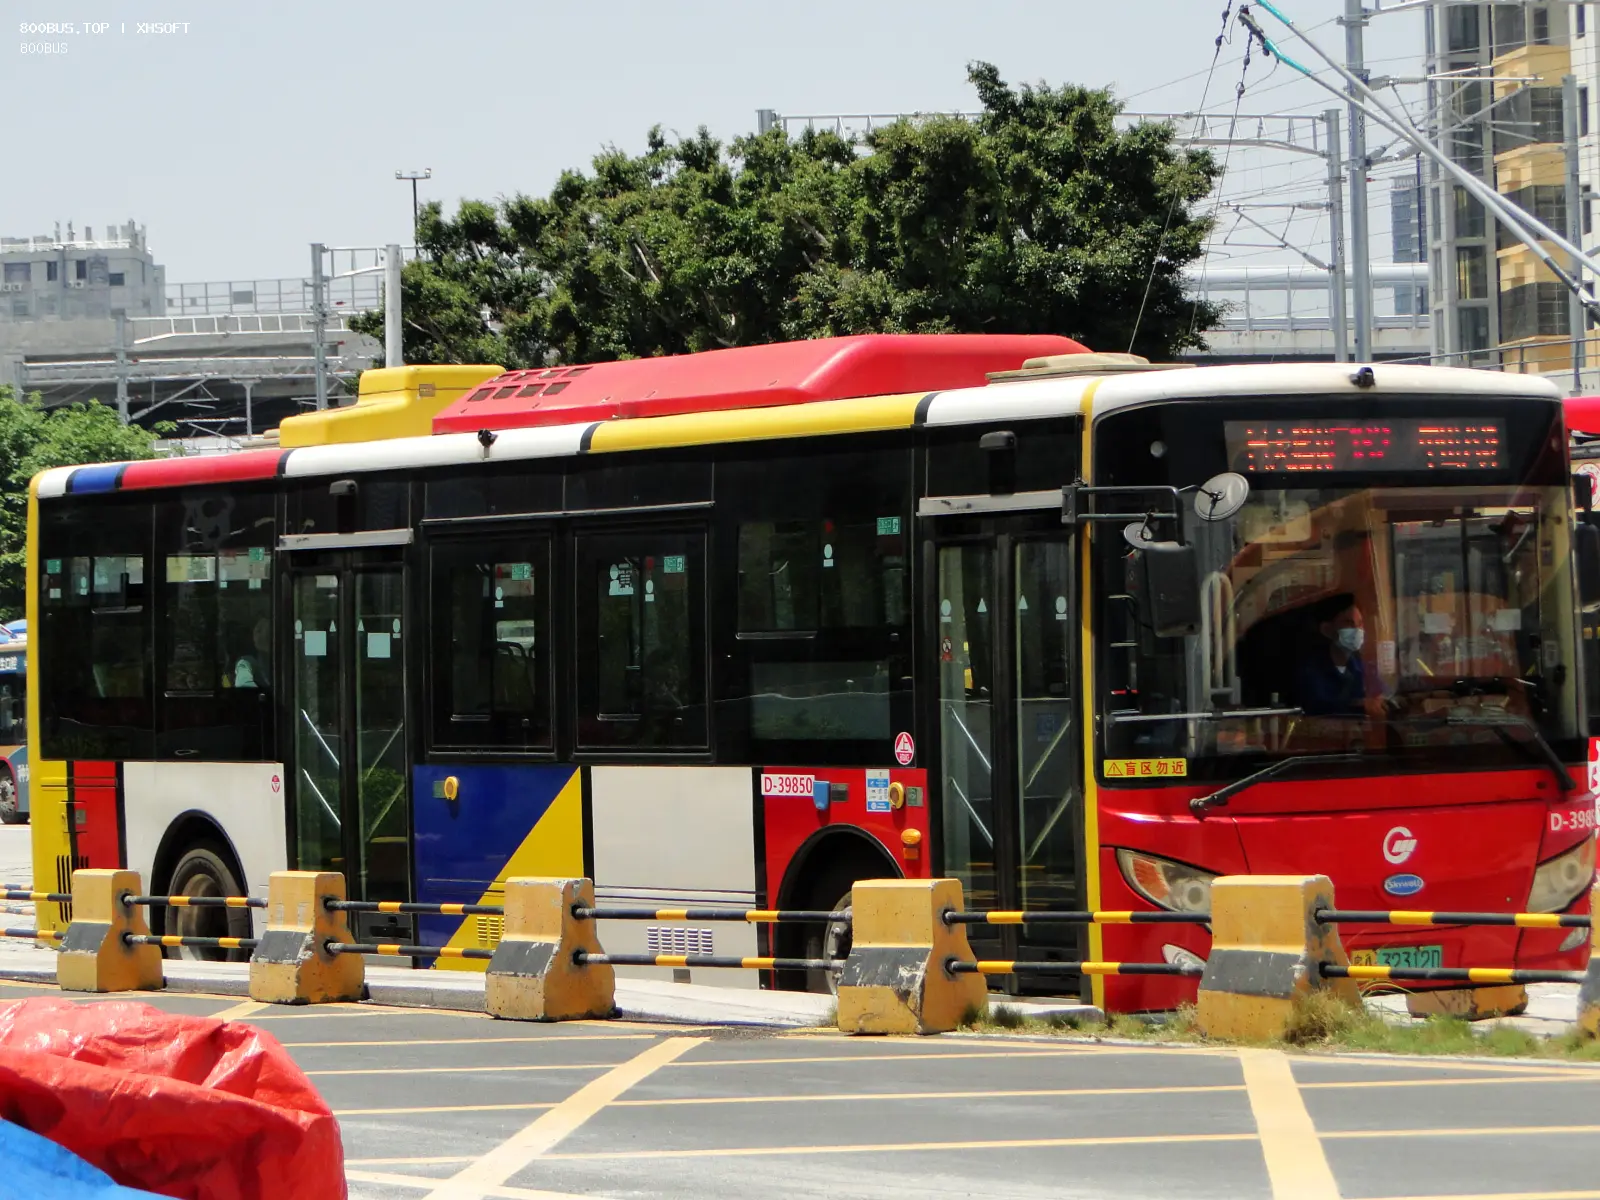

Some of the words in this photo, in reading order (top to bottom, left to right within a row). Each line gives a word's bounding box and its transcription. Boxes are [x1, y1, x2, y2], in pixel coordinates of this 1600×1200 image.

[1124, 760, 1184, 776] 盲区勿近
[763, 776, 813, 794] D-39850
